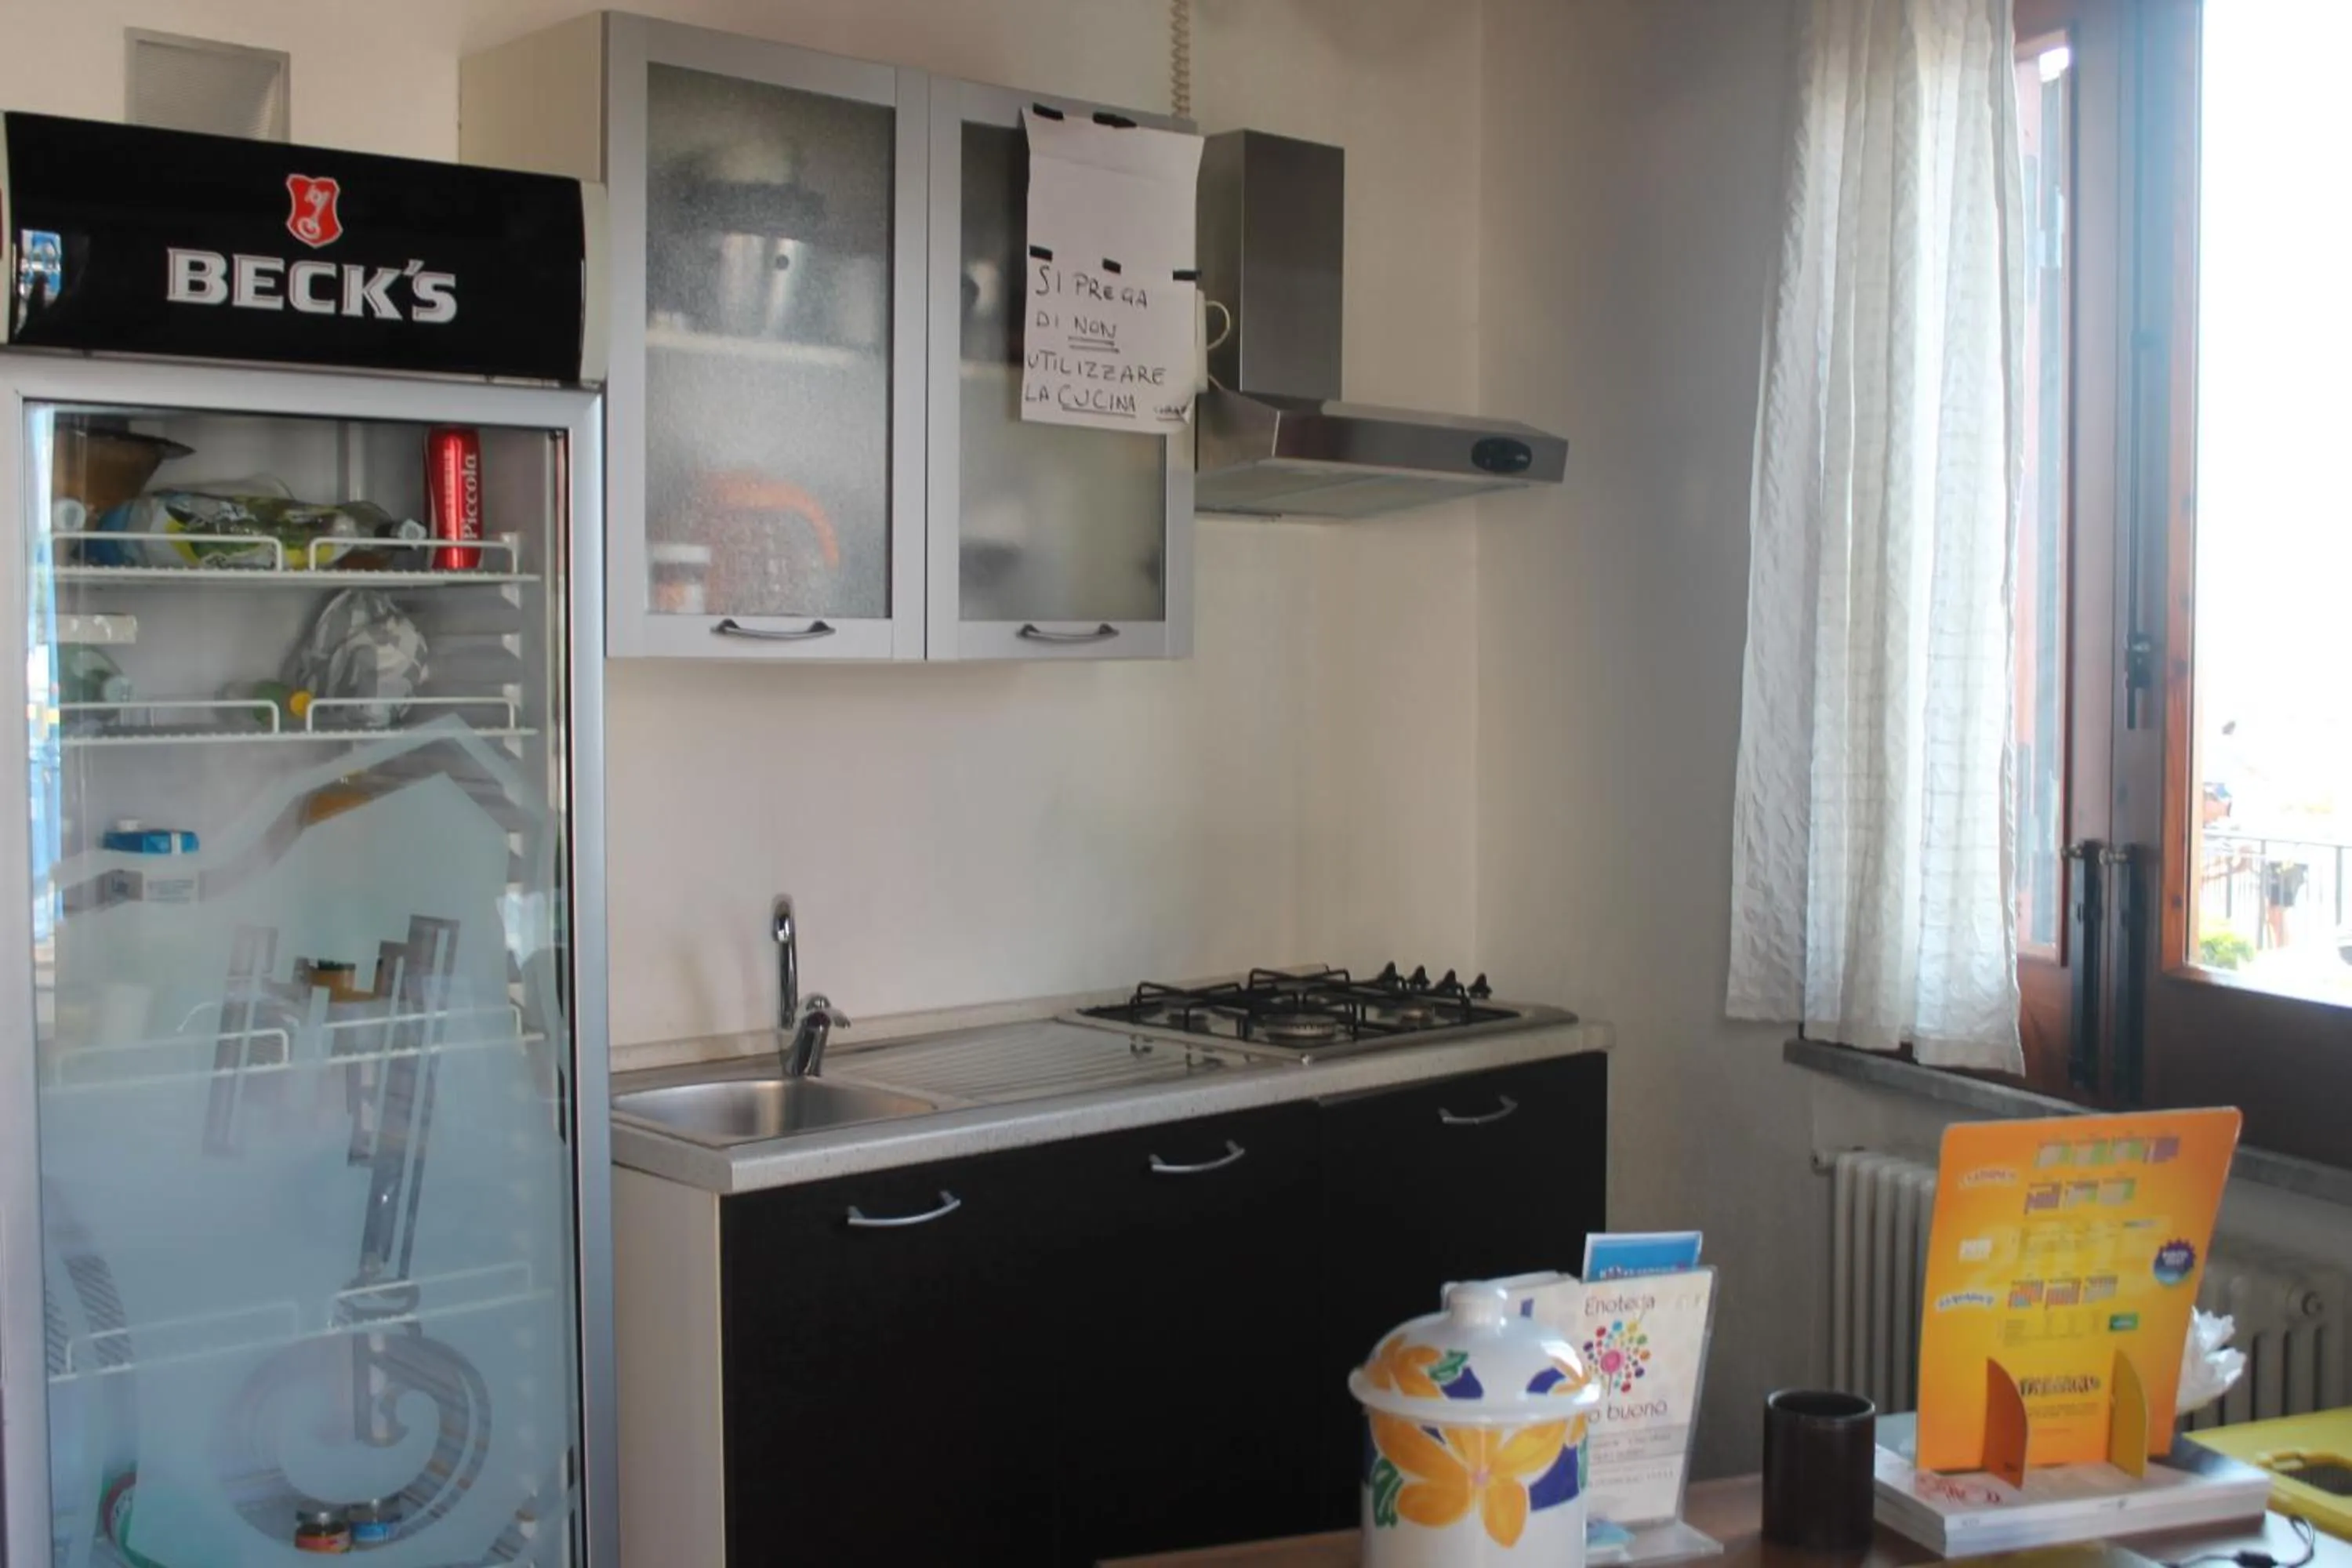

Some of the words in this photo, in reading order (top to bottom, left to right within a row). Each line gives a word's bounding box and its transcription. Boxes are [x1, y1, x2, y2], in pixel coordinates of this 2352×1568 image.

[166, 247, 459, 324] BECK'S
[1036, 265, 1062, 296] SI
[1075, 274, 1148, 308] PREGA
[1036, 311, 1059, 328] DI
[1073, 316, 1117, 339] NON
[1027, 350, 1167, 386] UTILIZZARE
[1025, 384, 1050, 402] LA
[1058, 384, 1136, 412] CUCINA
[462, 453, 477, 539] Piccola
